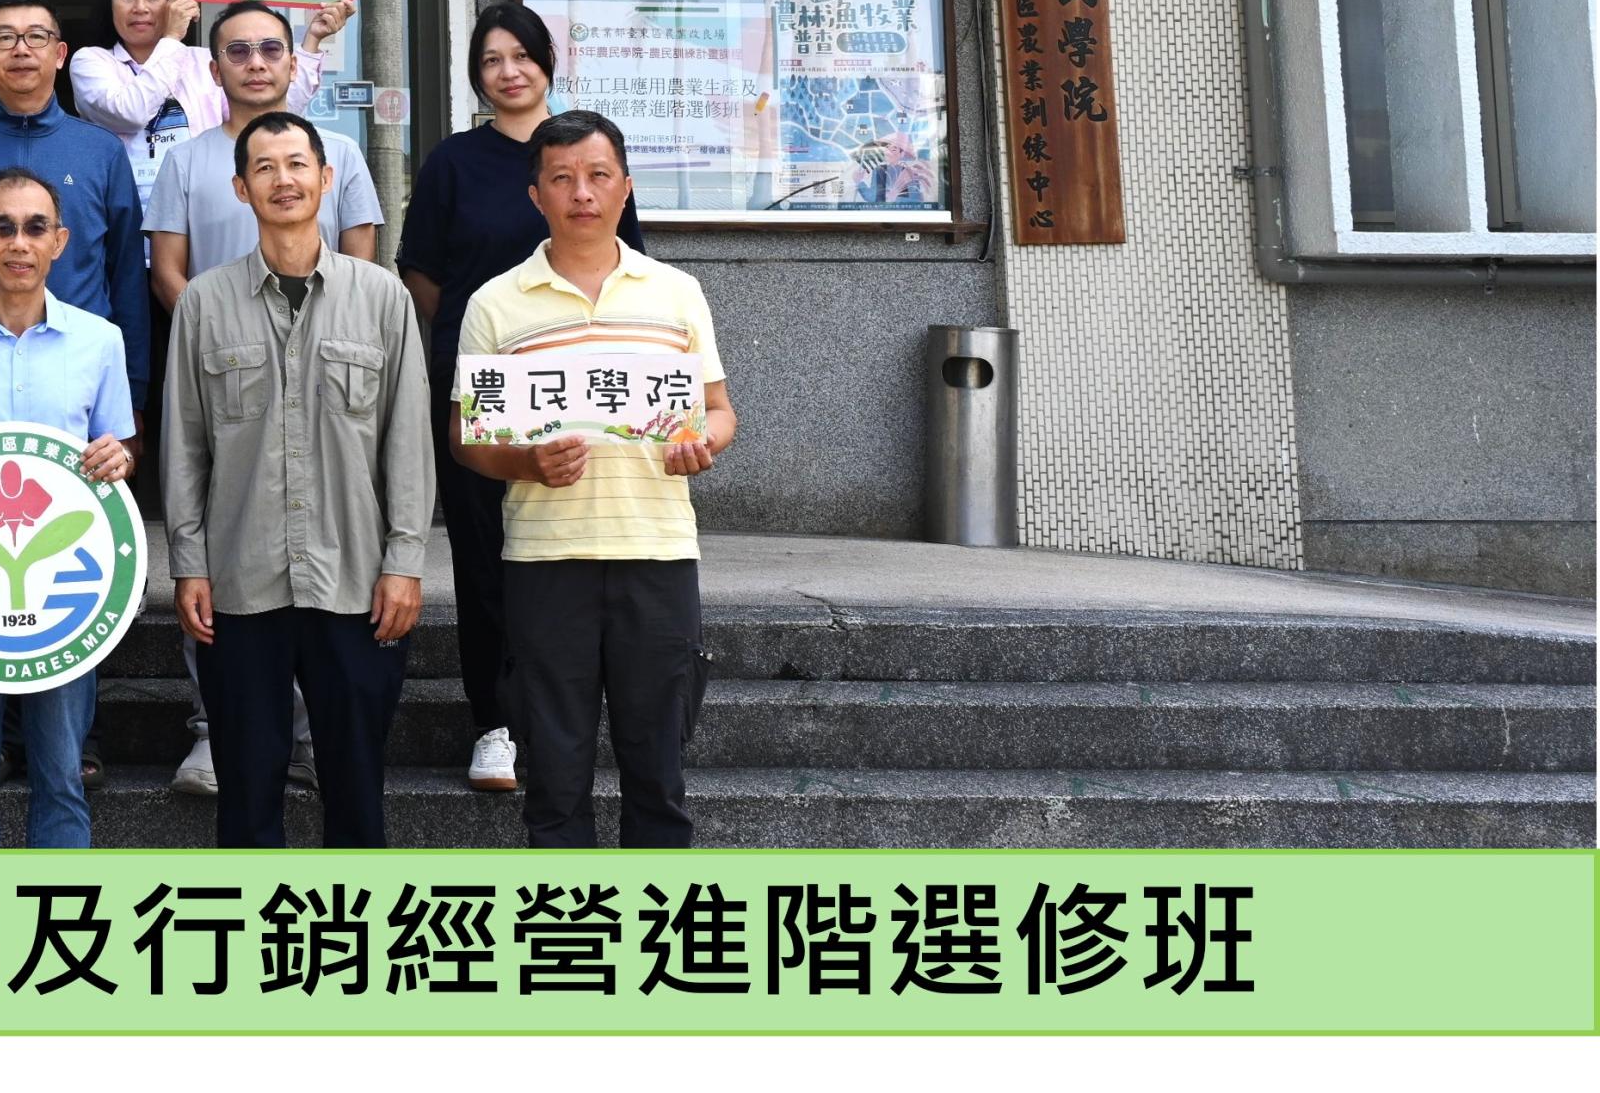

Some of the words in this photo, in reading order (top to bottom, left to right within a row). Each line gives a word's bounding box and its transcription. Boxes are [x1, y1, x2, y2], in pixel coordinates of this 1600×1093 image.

[590, 26, 728, 41] 農業部臺東區農業改良場
[794, 29, 833, 55] 普查
[555, 75, 758, 97] 數位工具應用農業生產及
[574, 97, 741, 119] 行銷經營進階選修班
[470, 368, 693, 414] 農民學院
[2, 614, 37, 628] 1928
[4, 649, 80, 679] DARES,
[82, 610, 119, 651] MOA
